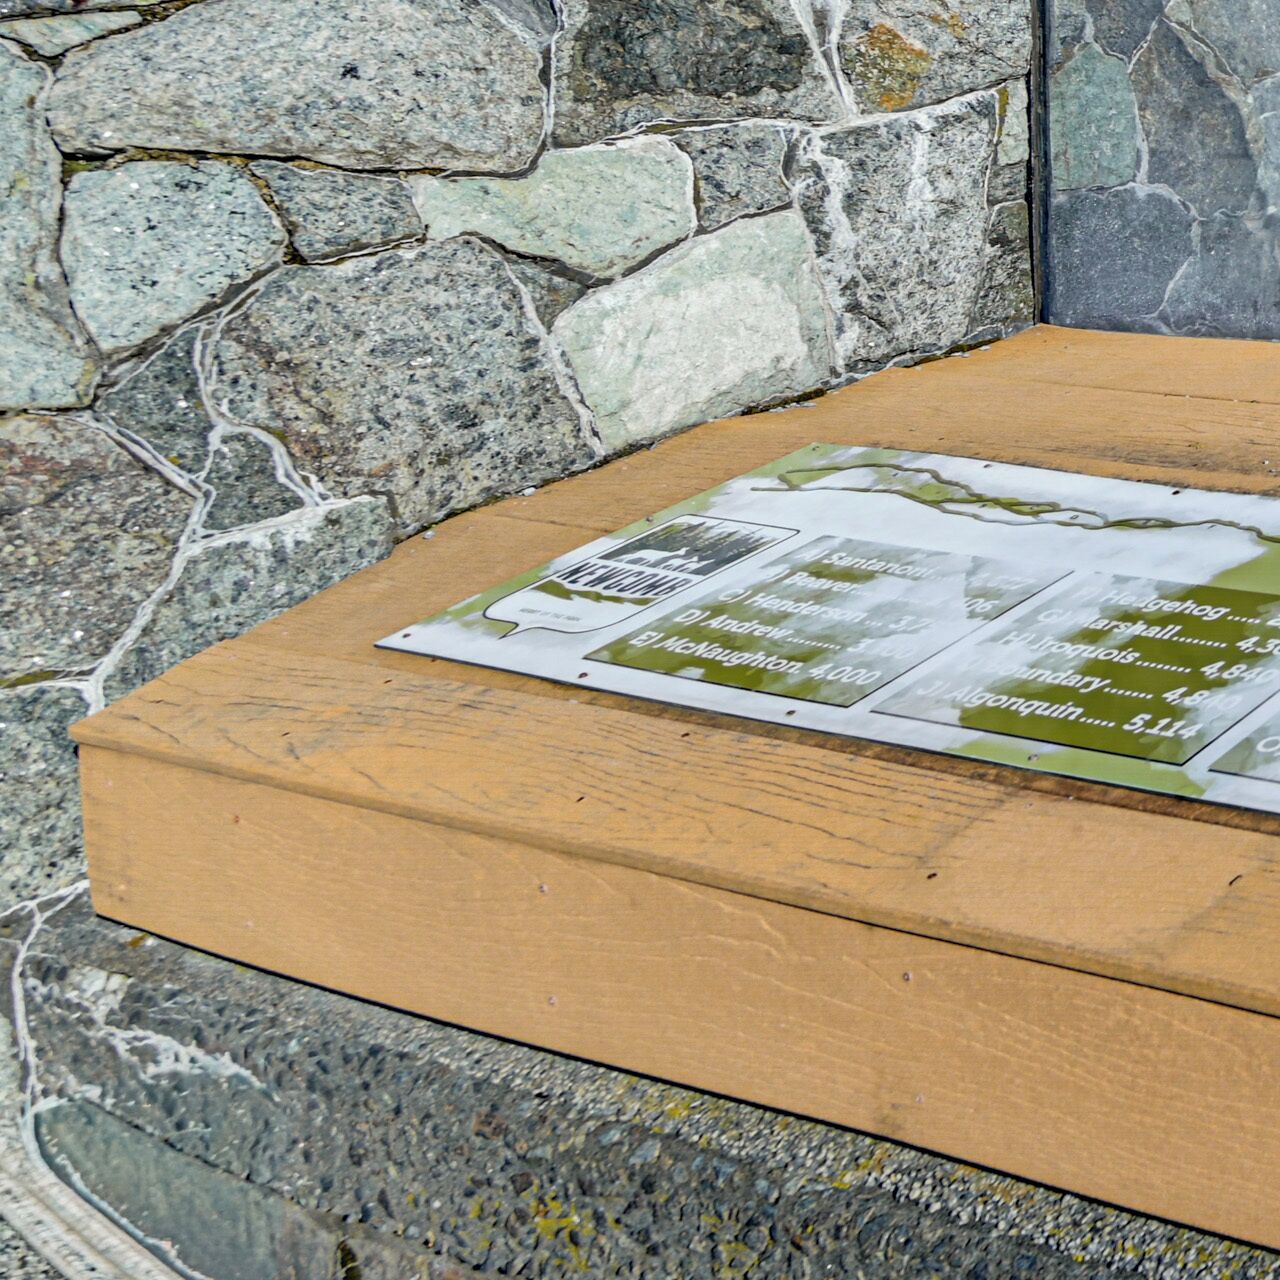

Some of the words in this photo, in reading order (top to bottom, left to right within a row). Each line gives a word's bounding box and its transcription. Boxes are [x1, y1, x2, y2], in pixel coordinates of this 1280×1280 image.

[556, 562, 693, 596] NEWCOMB
[822, 552, 939, 576] Santanoni
[782, 571, 861, 592] Beaver
[717, 588, 752, 603] C)
[744, 592, 867, 622] Henderson
[1099, 590, 1230, 620] Hedgehog
[672, 609, 710, 625] D)
[700, 614, 793, 639] Andrew
[628, 631, 664, 647] E)
[809, 663, 881, 684] 4,000
[997, 631, 1036, 647] H)
[1031, 636, 1139, 663] Iroquois
[1200, 660, 1279, 683] 4,840
[915, 679, 950, 696] J)
[944, 686, 1083, 720] Algonquin
[1122, 713, 1202, 739] 5,114
[1162, 686, 1242, 710] 4,840
